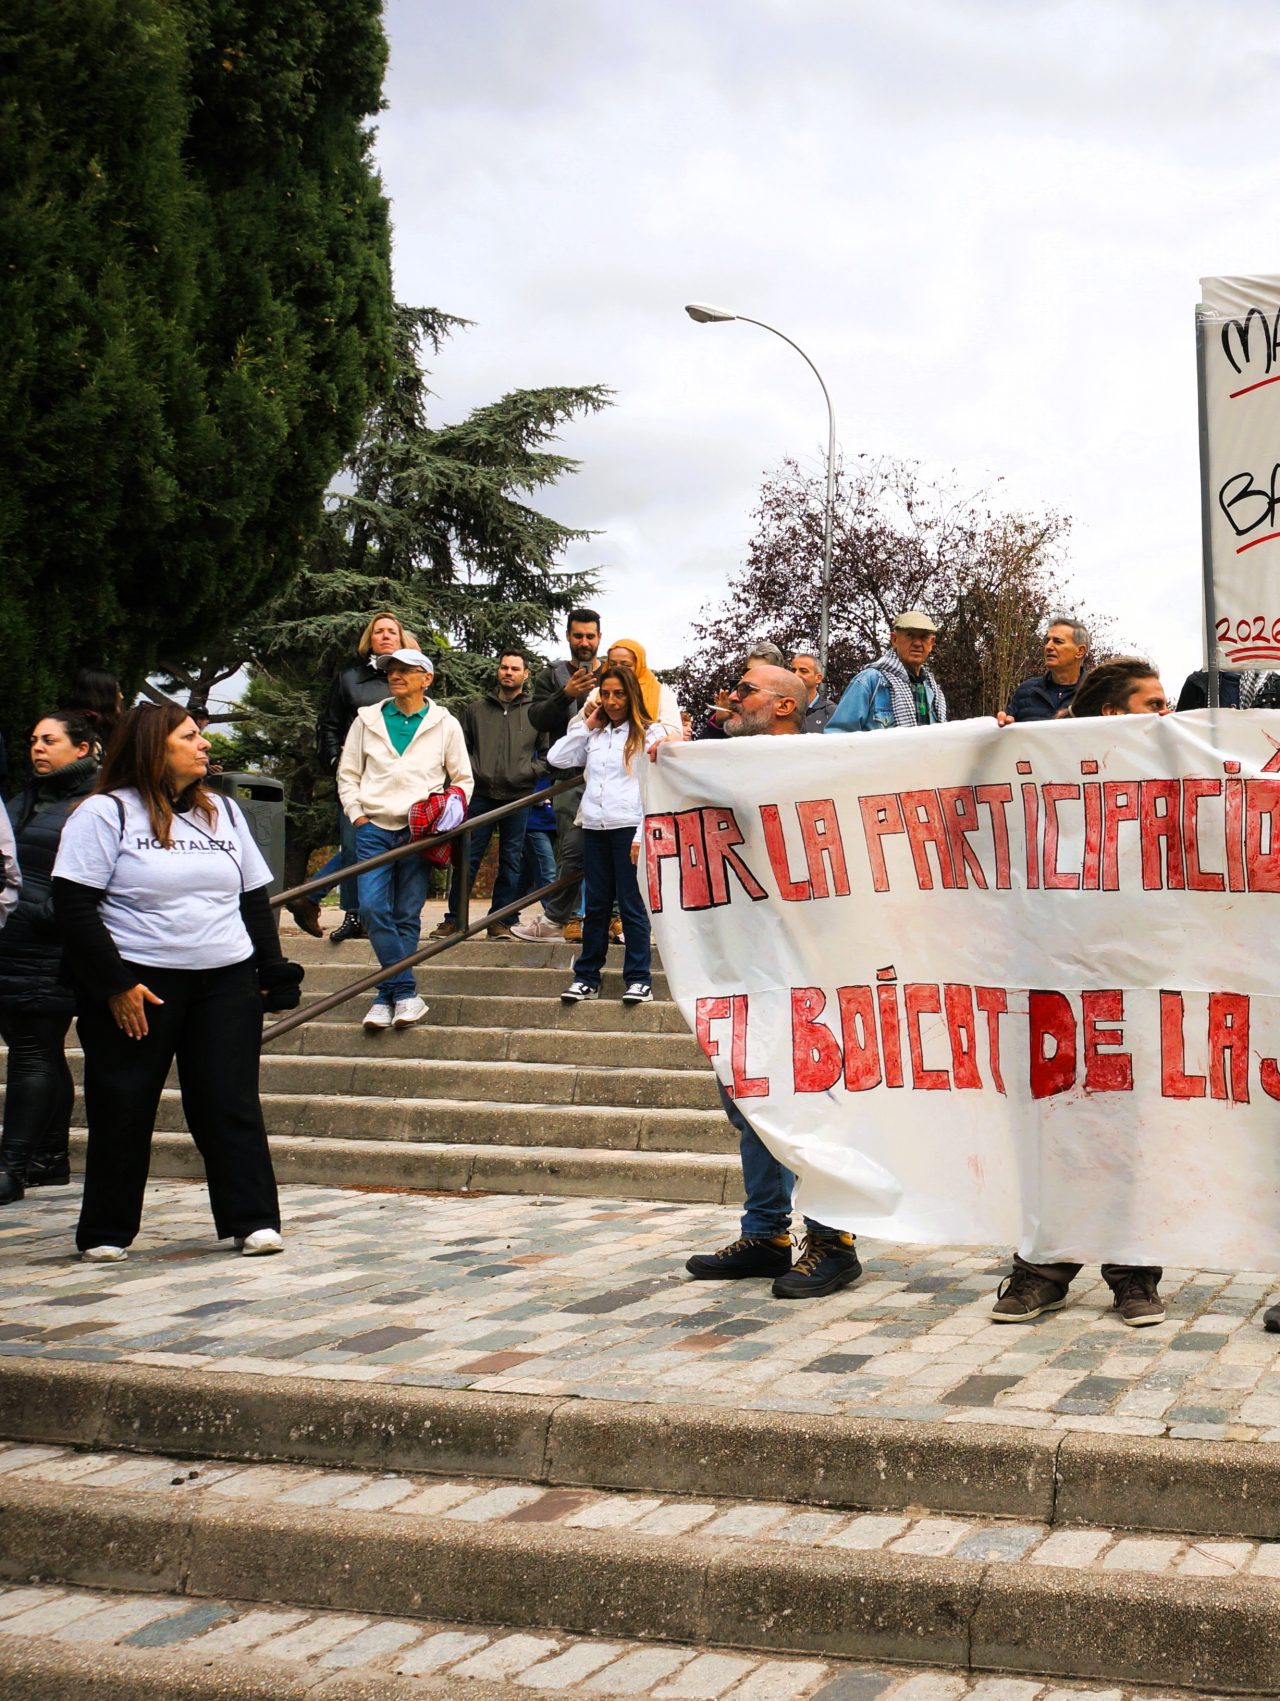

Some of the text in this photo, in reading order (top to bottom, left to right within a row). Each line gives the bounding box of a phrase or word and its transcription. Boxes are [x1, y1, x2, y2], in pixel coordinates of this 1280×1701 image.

[136, 837, 237, 852] HORTALEZA
[644, 806, 769, 913] POR
[758, 799, 851, 902] LA
[696, 994, 769, 1100] EL
[1028, 988, 1134, 1099] DE
[1159, 989, 1251, 1104] LA
